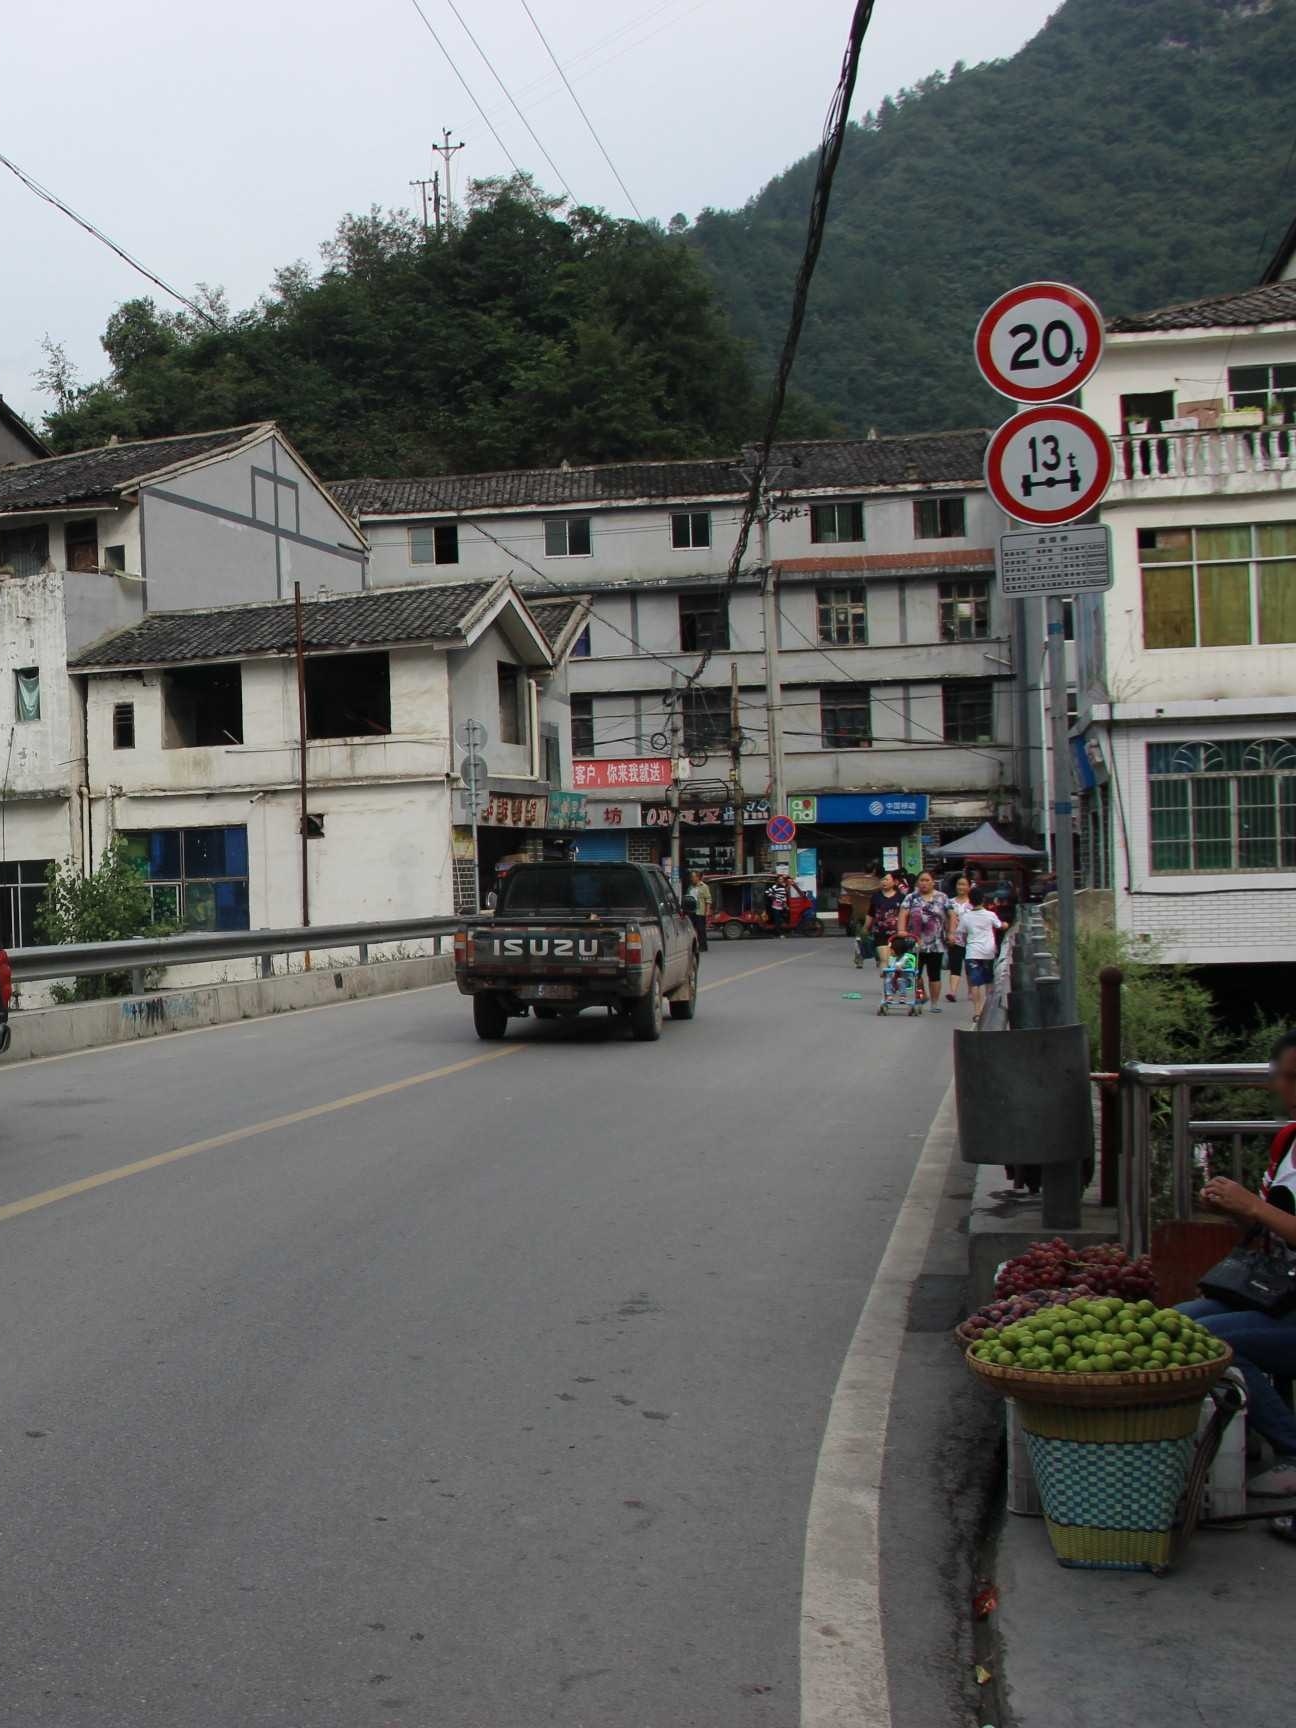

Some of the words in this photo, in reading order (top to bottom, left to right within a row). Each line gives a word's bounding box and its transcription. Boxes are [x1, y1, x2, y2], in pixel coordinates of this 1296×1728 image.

[1008, 319, 1084, 371] 20t
[1028, 435, 1076, 472] 13t
[572, 763, 664, 784] 客户，你来我就送!
[493, 939, 598, 956] ISUZU
